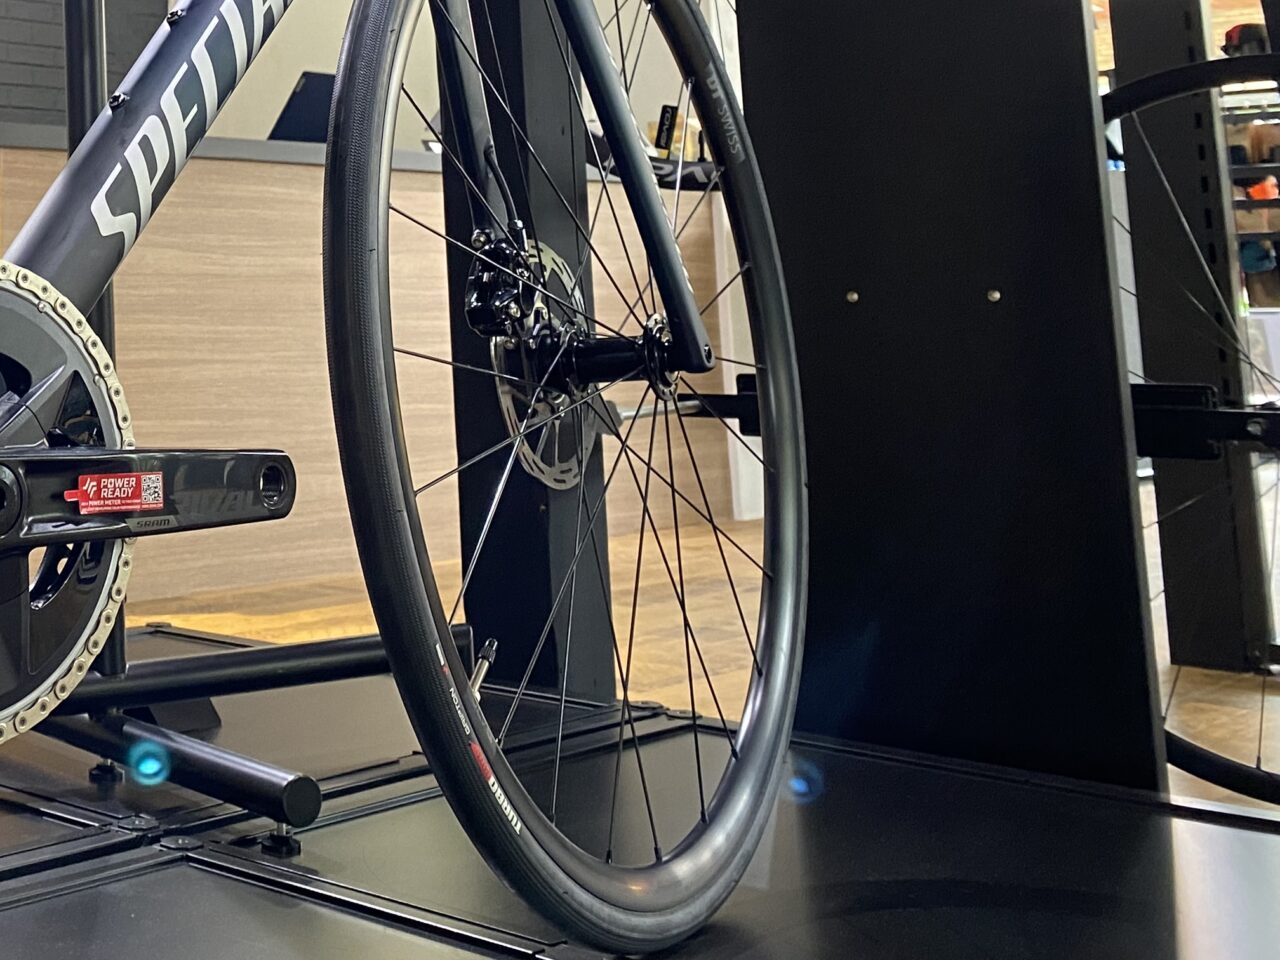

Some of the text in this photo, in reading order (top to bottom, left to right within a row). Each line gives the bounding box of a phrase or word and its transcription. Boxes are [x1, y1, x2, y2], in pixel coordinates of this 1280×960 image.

[717, 103, 742, 154] SWISS
[100, 477, 136, 489] POWER
[100, 487, 134, 499] READY
[136, 518, 170, 528] SRAM
[449, 687, 471, 736] GRIPTON
[487, 774, 523, 836] TURBO
